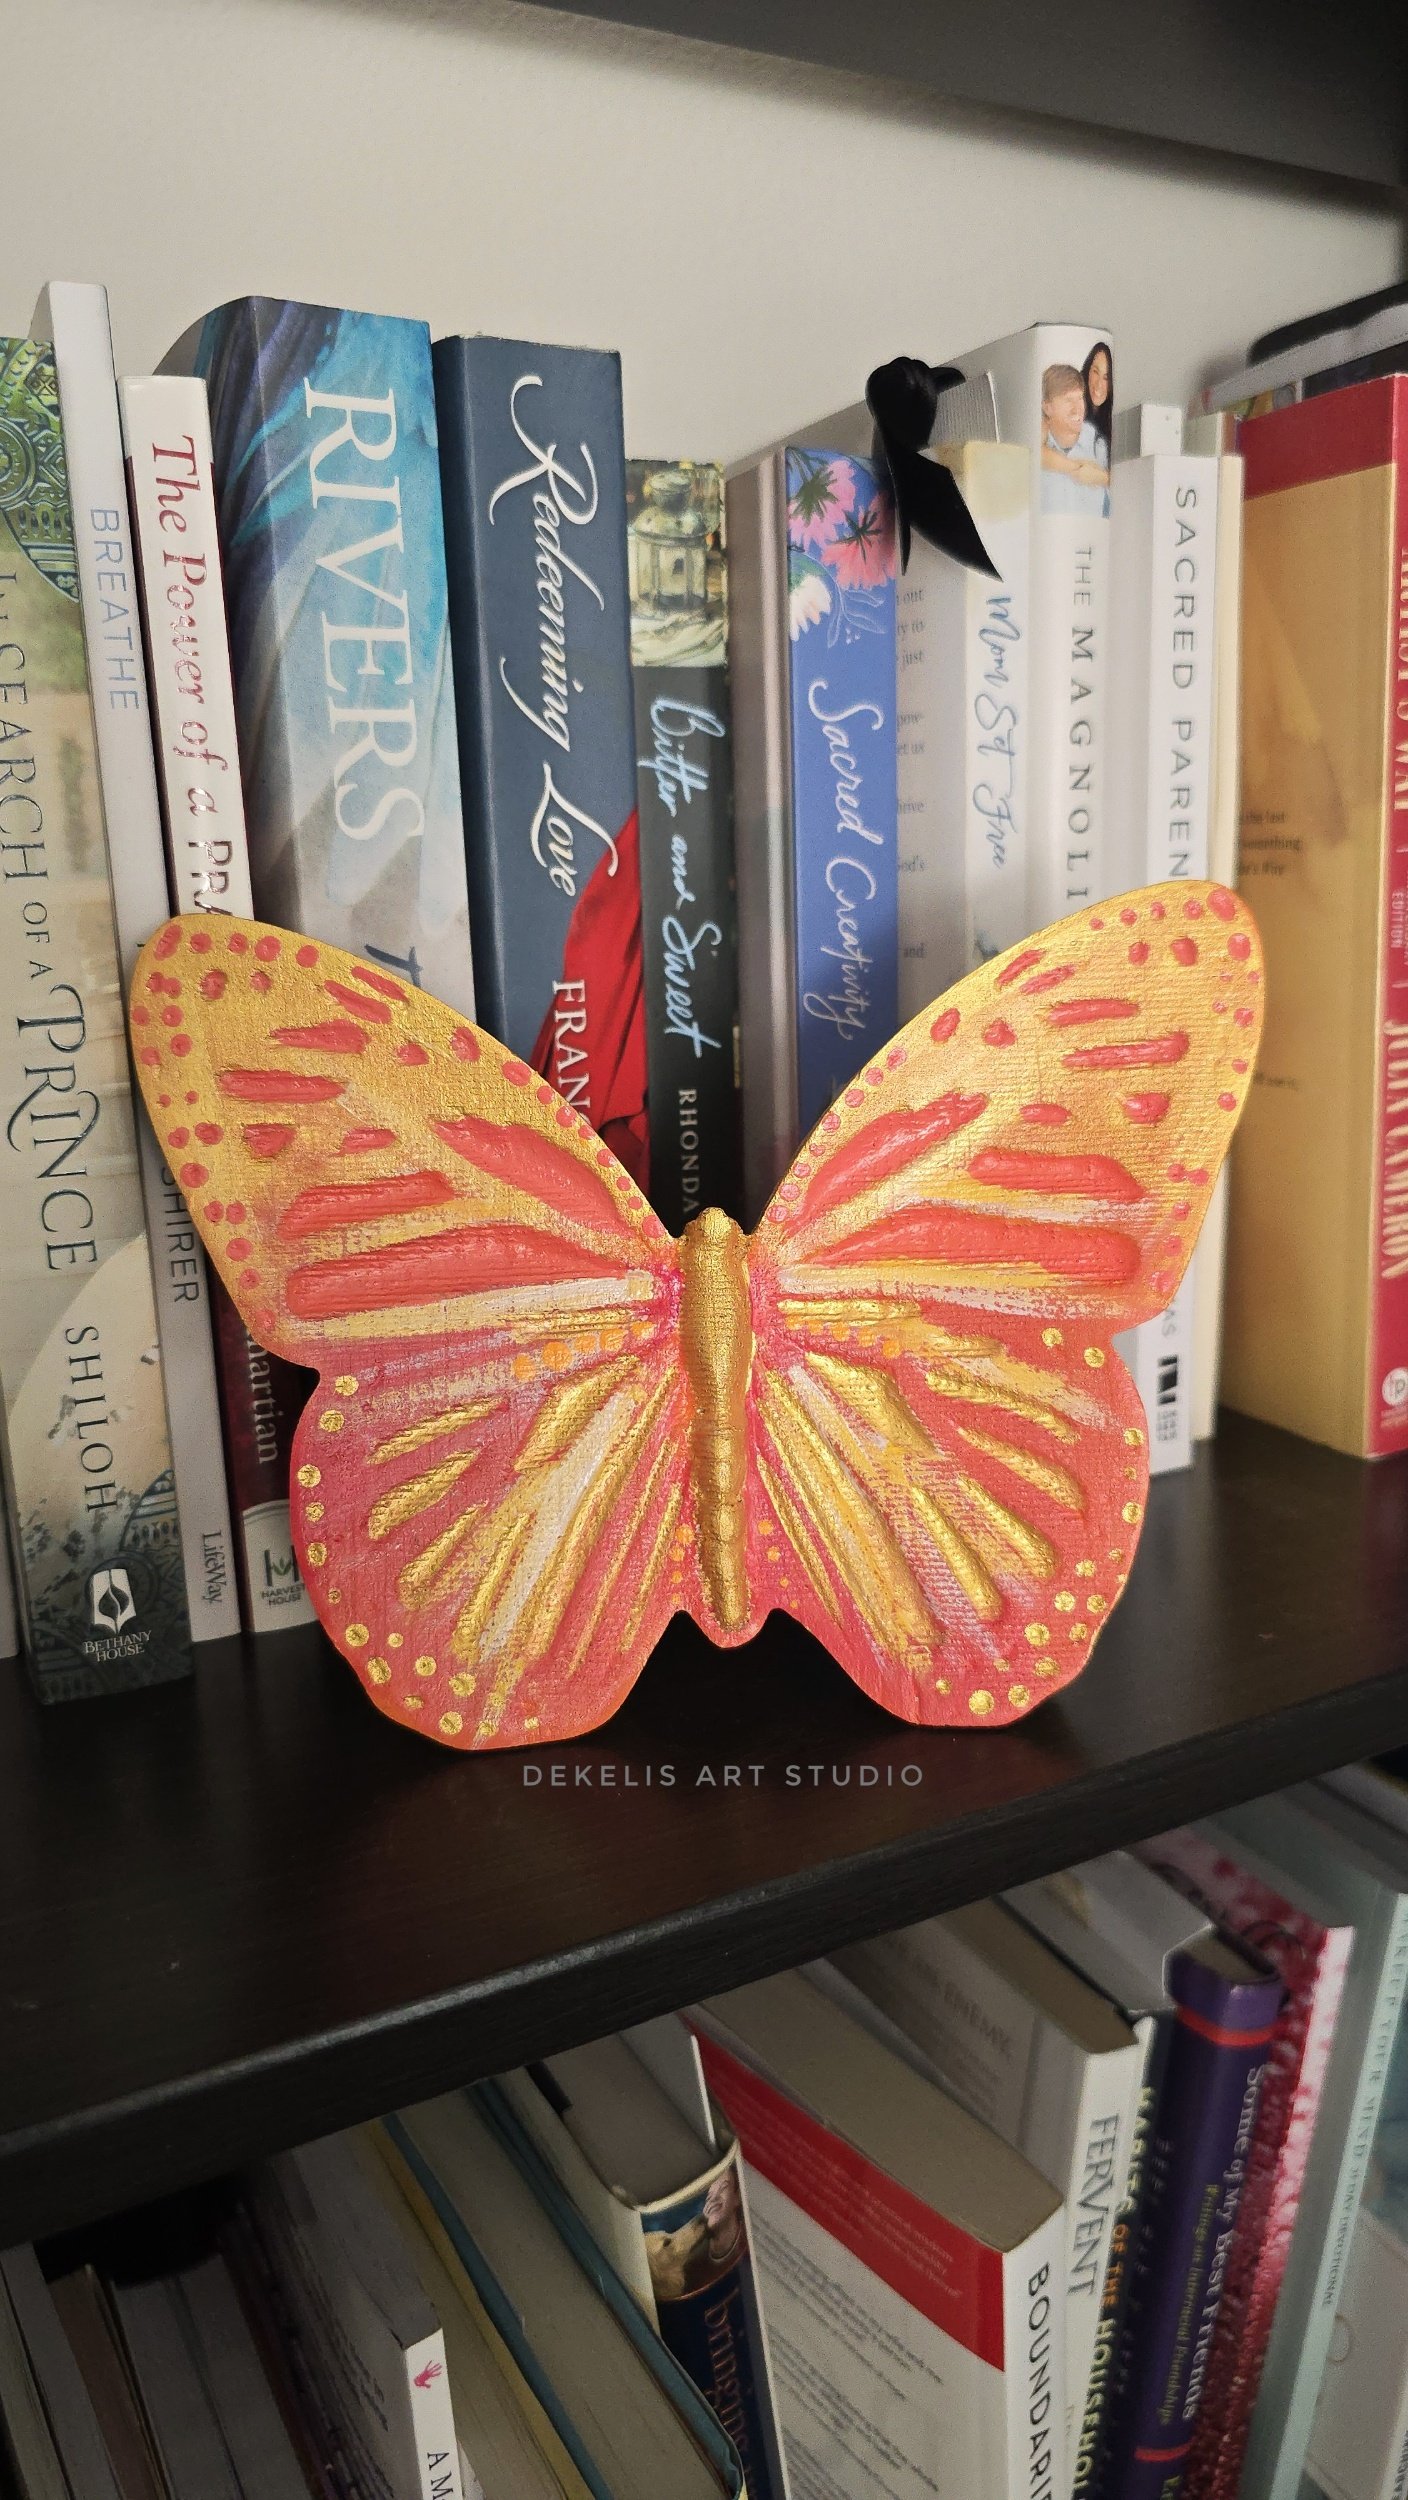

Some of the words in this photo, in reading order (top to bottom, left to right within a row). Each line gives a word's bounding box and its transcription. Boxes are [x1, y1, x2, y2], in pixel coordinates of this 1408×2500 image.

[152, 434, 201, 533] The
[90, 508, 139, 709] BREATHE
[303, 376, 425, 840] RIVERS
[490, 375, 604, 752] Redeeming
[1073, 546, 1093, 606] THE
[1172, 486, 1197, 691] SACRED
[162, 550, 208, 704] Power
[173, 720, 229, 771] of
[636, 696, 726, 818] Bitter
[808, 680, 885, 847] Sacred
[1066, 625, 1094, 899] MAGNOLI
[187, 786, 219, 817] a
[530, 762, 618, 898] Love
[1168, 719, 1194, 878] PAREN
[671, 833, 697, 911] and
[1391, 888, 1405, 949] EDITION
[22, 901, 51, 945] OF
[29, 960, 54, 980] A
[802, 855, 878, 1041] Creativity
[661, 914, 723, 1059] Sweet
[7, 984, 100, 1271] PRINCE
[678, 1088, 701, 1213] RHONDA
[65, 1326, 119, 1513] SHILOH
[202, 1530, 227, 1604] LifeWay
[269, 1593, 302, 1607] HOUSE
[83, 1630, 153, 1655] BETHANY
[96, 1643, 146, 1662] HOUSE
[1118, 2086, 1154, 2215] HABITS
[1234, 2064, 1265, 2153] Some
[1067, 2113, 1119, 2298] FERVENT
[1216, 2186, 1241, 2224] My
[1223, 2158, 1245, 2181] of
[1101, 2260, 1123, 2307] THE
[1109, 2223, 1131, 2254] OF
[1206, 2229, 1237, 2297] Best
[1182, 2302, 1220, 2422] Friends
[427, 2452, 450, 2471] A
[430, 2470, 454, 2500] M
